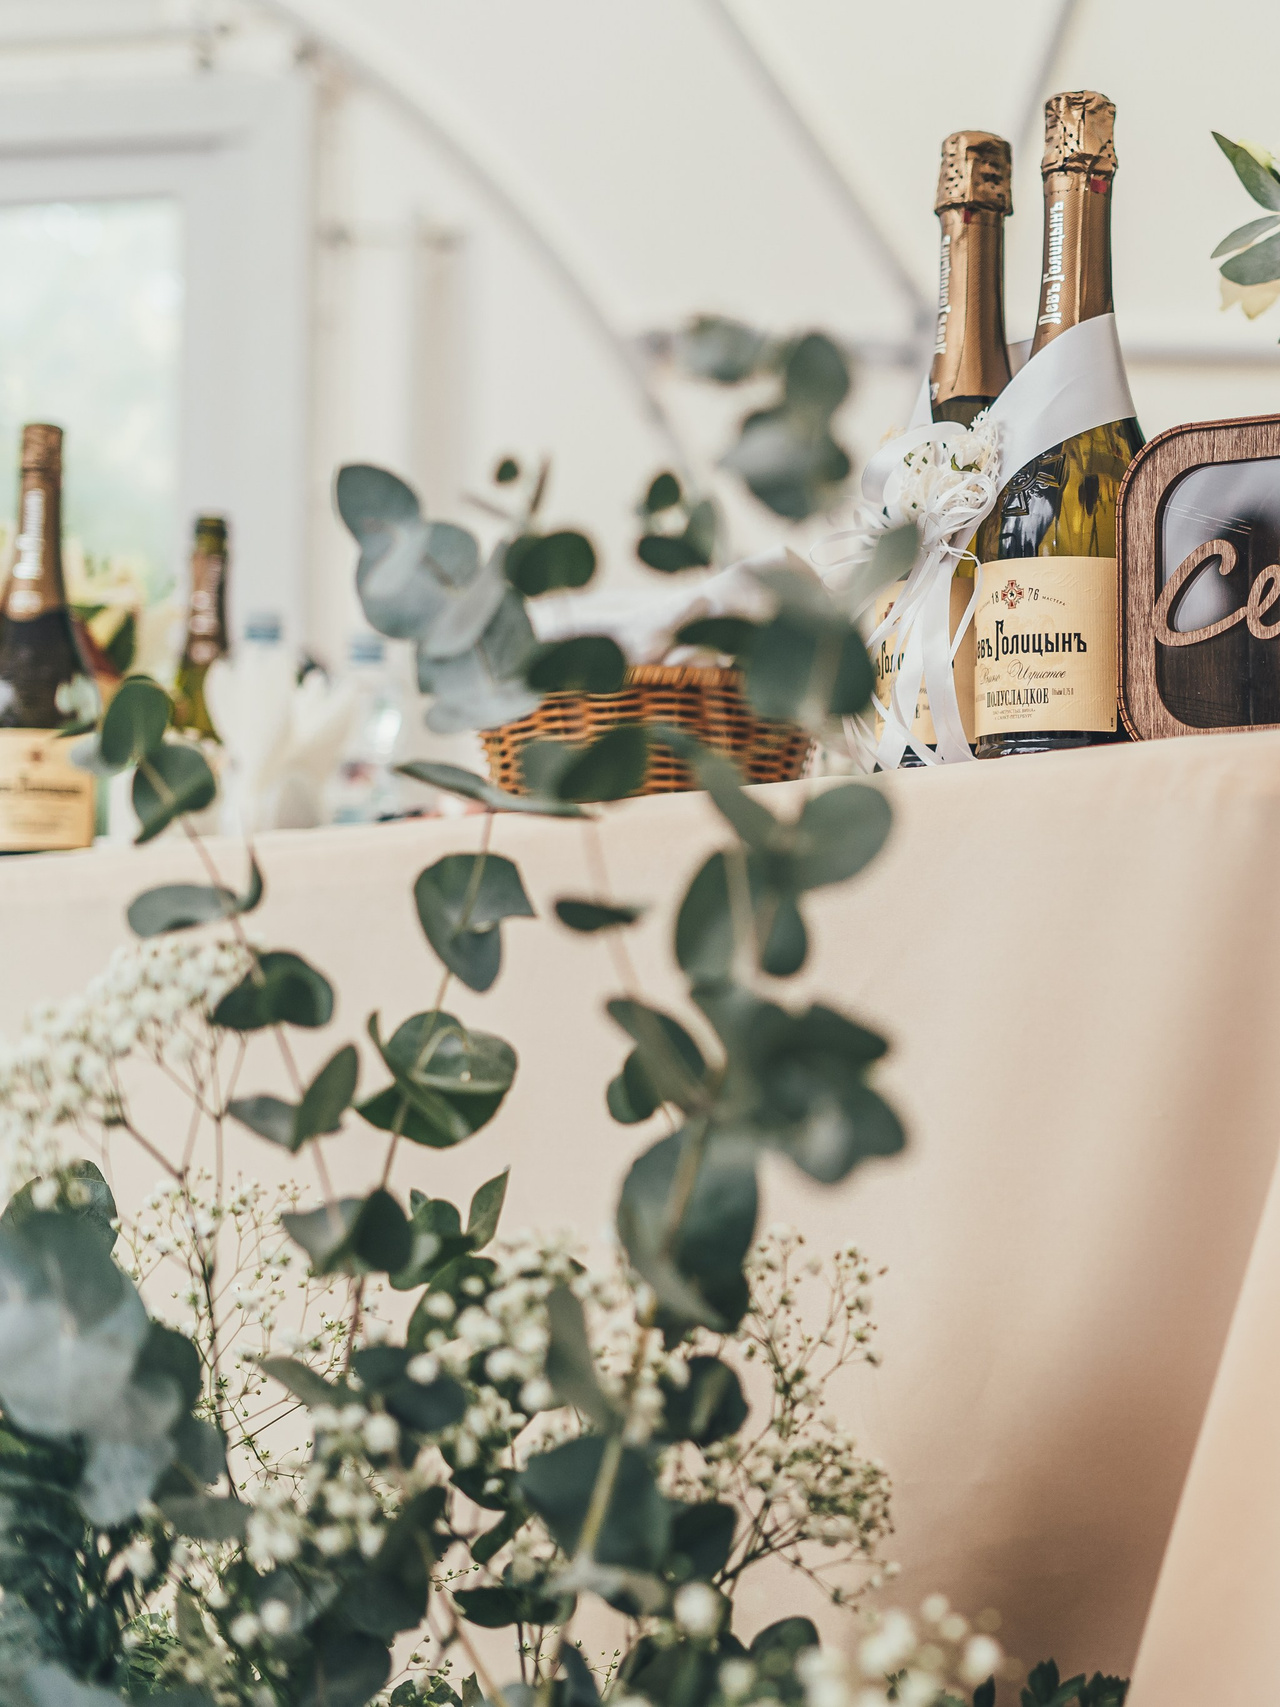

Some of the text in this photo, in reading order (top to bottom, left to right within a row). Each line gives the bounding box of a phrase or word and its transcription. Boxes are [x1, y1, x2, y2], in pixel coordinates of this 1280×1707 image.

[1038, 201, 1065, 326] Левъ Голицынъ
[991, 587, 1040, 605] 18 76
[1042, 595, 1066, 607] МАСТЕРА
[977, 620, 1087, 662] евъ Голицынъ
[1007, 659, 1067, 686] Игристое
[986, 687, 1050, 708] ПОЛУСЛАДКОЕ
